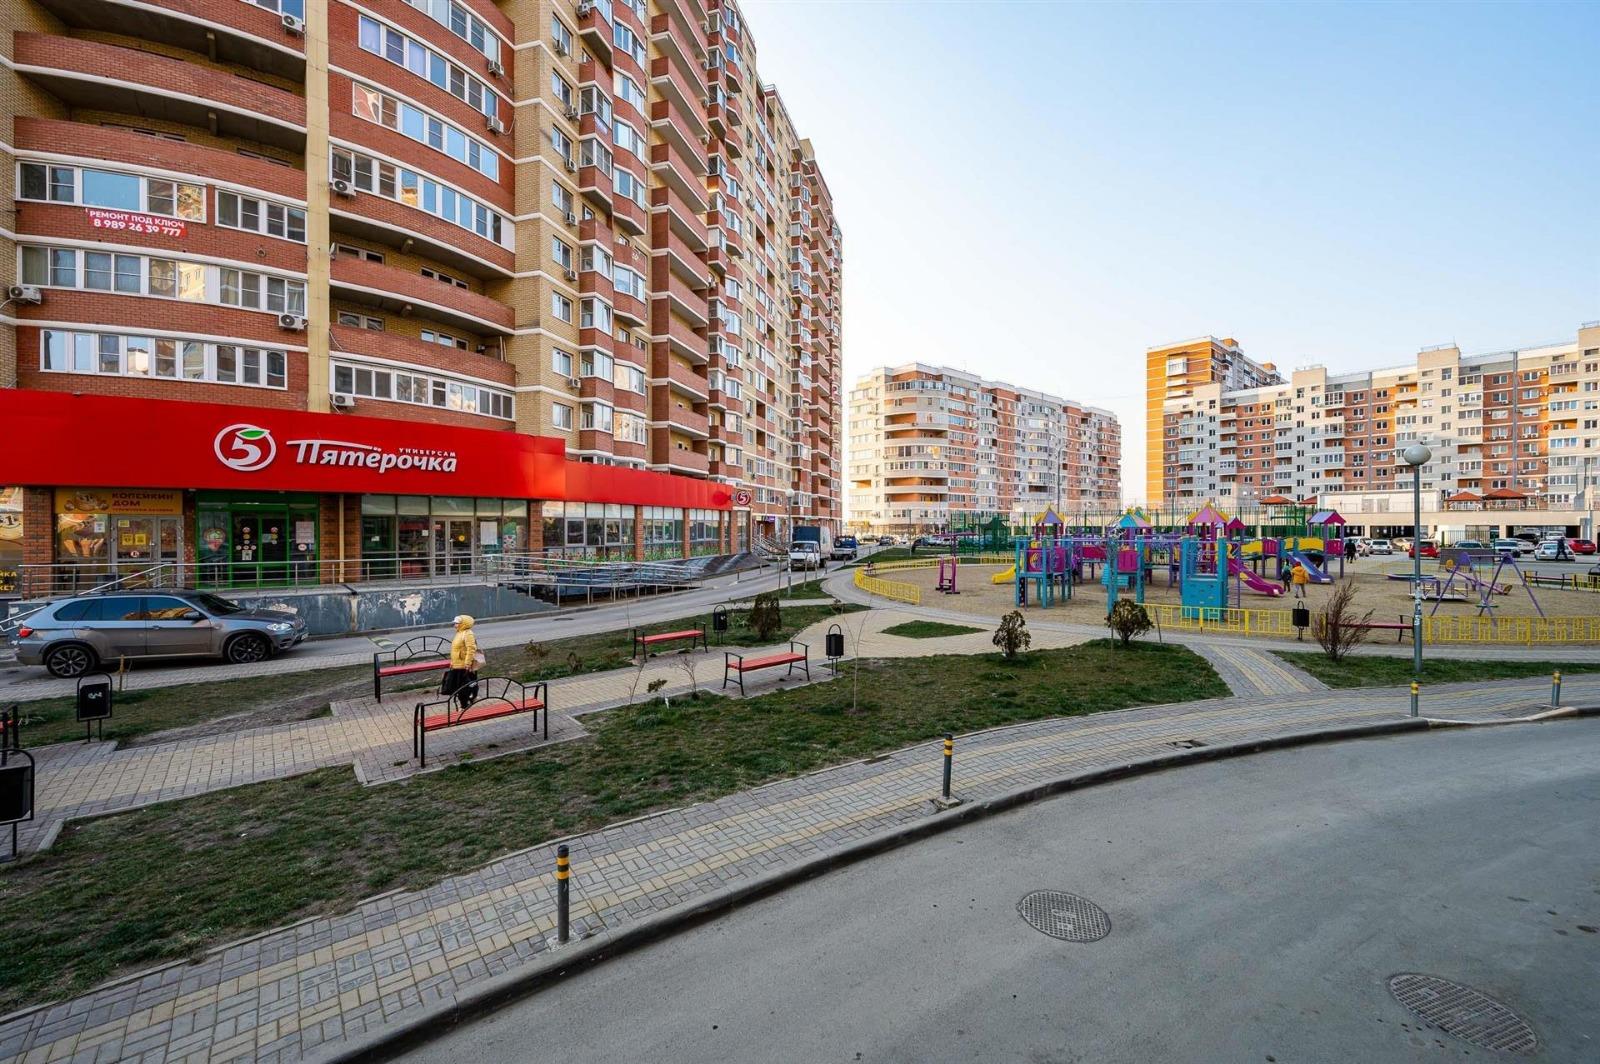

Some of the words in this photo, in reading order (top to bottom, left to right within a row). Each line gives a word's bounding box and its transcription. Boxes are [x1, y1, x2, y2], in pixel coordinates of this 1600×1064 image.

[89, 210, 129, 221] РЕМОНТ
[131, 215, 153, 225] ПОД
[155, 218, 185, 229] КЛЮЧ
[94, 219, 102, 227] 8
[103, 220, 126, 229] 989
[128, 222, 143, 232] 26
[145, 224, 159, 233] 39
[161, 226, 181, 237] 777
[286, 439, 458, 474] Пятёрочка
[399, 447, 457, 458] УНИВЕРСАМ
[112, 499, 141, 507] ДОМ
